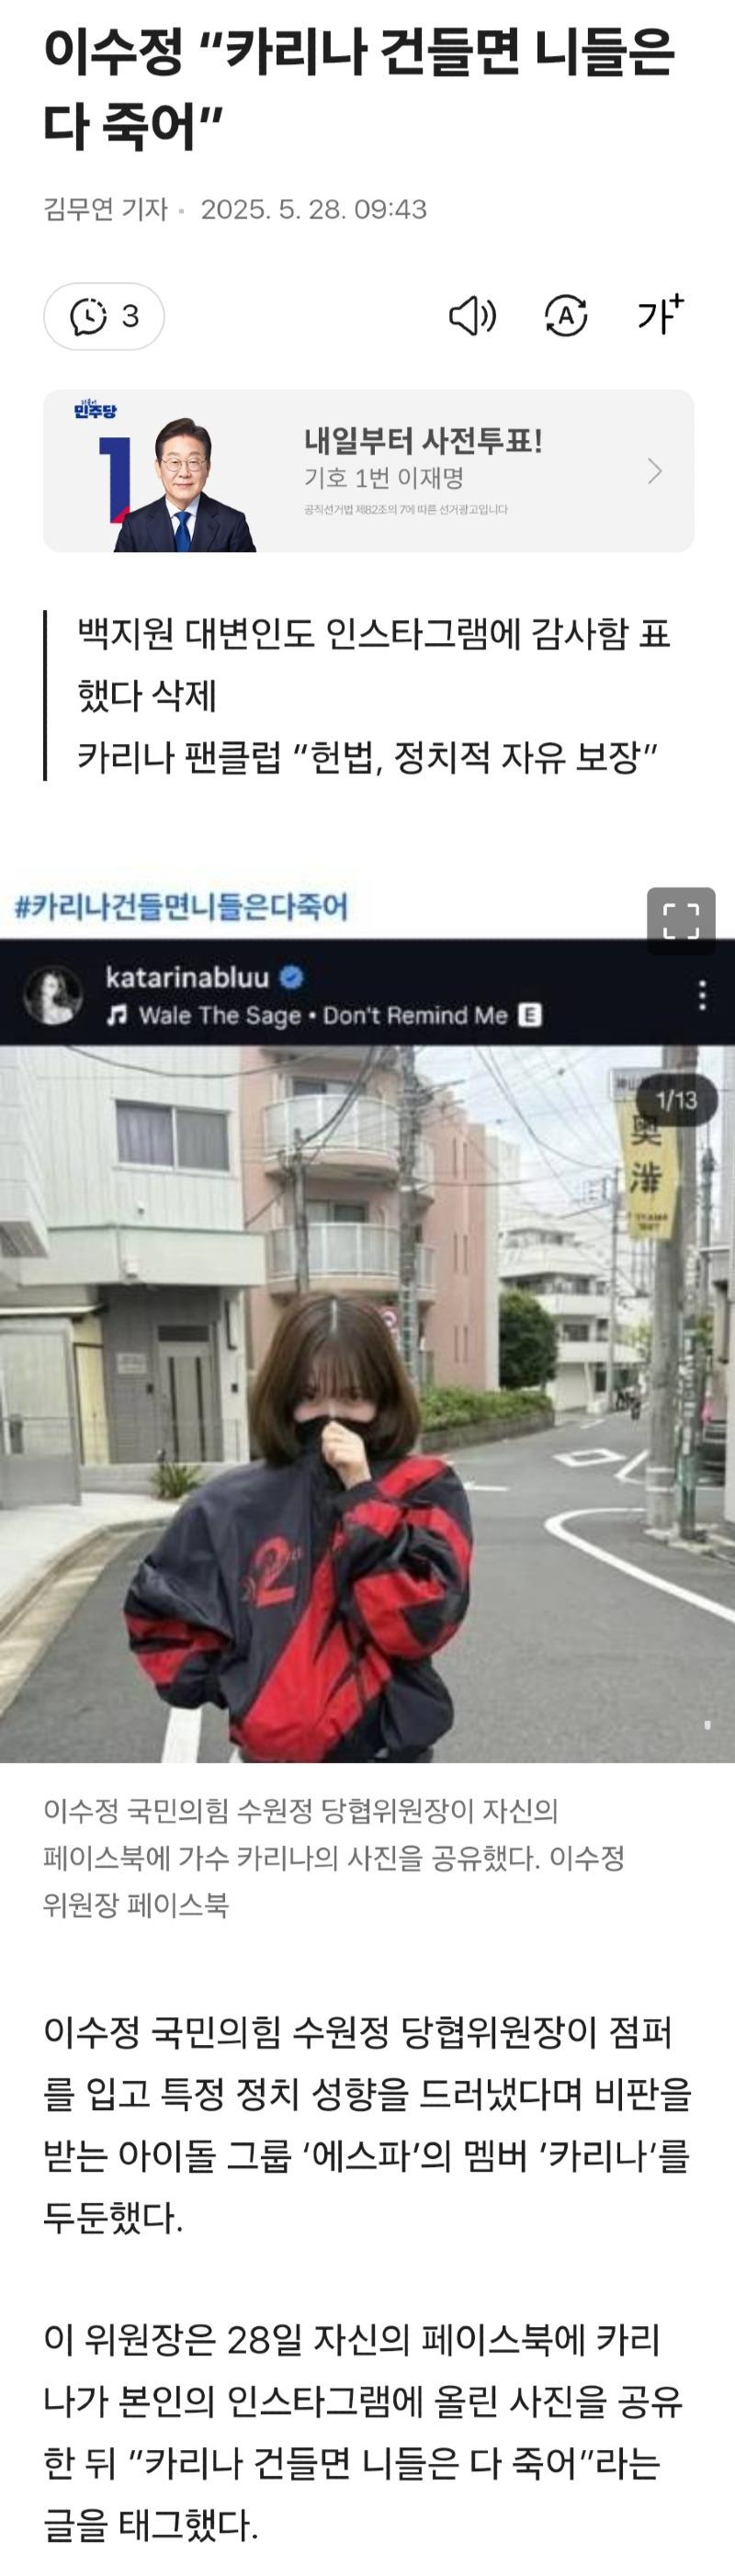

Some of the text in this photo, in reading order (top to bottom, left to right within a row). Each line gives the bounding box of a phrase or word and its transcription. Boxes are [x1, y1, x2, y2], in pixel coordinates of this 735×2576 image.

[45, 27, 182, 77] 이수정
[380, 27, 519, 77] 건들면
[537, 27, 675, 77] 니들은
[44, 101, 91, 152] 다
[44, 197, 169, 222] 김무연 기자
[201, 198, 427, 220] 2025. 5. 28. 09:43
[122, 303, 140, 328] 3
[558, 305, 575, 325] A
[74, 404, 118, 419] 민주당
[305, 426, 542, 456] 내일부터 사전투표!
[98, 436, 130, 524] 1
[305, 466, 463, 491] 기호 1번 이재명
[304, 503, 508, 515] 공직선거법 제82조의 7에 따른 선거광고입니다
[78, 616, 671, 651] 백지원 대변인도 인스타그램에 감사함 표
[77, 679, 216, 714] 했다 삭제
[78, 740, 175, 775] 카리나
[185, 740, 280, 775] 팬클럽
[394, 740, 489, 775] 정치적
[502, 740, 567, 775] 자유
[14, 891, 347, 922] #카리나건들면니들은다죽어
[107, 965, 269, 989] katarinabluu
[139, 1004, 302, 1031] Wale The Sage
[323, 1005, 380, 1025] Don't
[387, 1005, 469, 1025] Remind
[475, 1005, 509, 1025] Me
[254, 1534, 295, 1609] 2
[44, 1797, 558, 1825] 이수정 국민의힘 수원정 당협위원장이 자신의
[43, 1845, 624, 1873] 페이스북에 가수 카리나의 사진을 공유했다. 이수정
[42, 1892, 230, 1919] 위원장 페이스북
[44, 2015, 671, 2051] 이수정 국민의힘 수원정 당협위원장이 점퍼
[43, 2077, 692, 2112] 를 입고 특정 정치 성향을 드러냈다며 비판을
[44, 2139, 108, 2173] 받는
[119, 2139, 217, 2174] 아이돌
[227, 2139, 292, 2174] 그룹
[464, 2139, 526, 2174] 멤버
[43, 2201, 183, 2236] 두둔했다.
[44, 2322, 659, 2357] 이 위원장은 28일 자신의 페이스북에 카리
[44, 2384, 684, 2420] 나가 본인의 인스타그램에 올린 사진을 공유
[43, 2446, 76, 2480] 한
[85, 2446, 115, 2481] 뒤
[254, 2446, 350, 2481] 건들면
[364, 2446, 459, 2481] 니들은
[470, 2446, 503, 2481] 다
[43, 2508, 258, 2543] 글을 태그했다.
